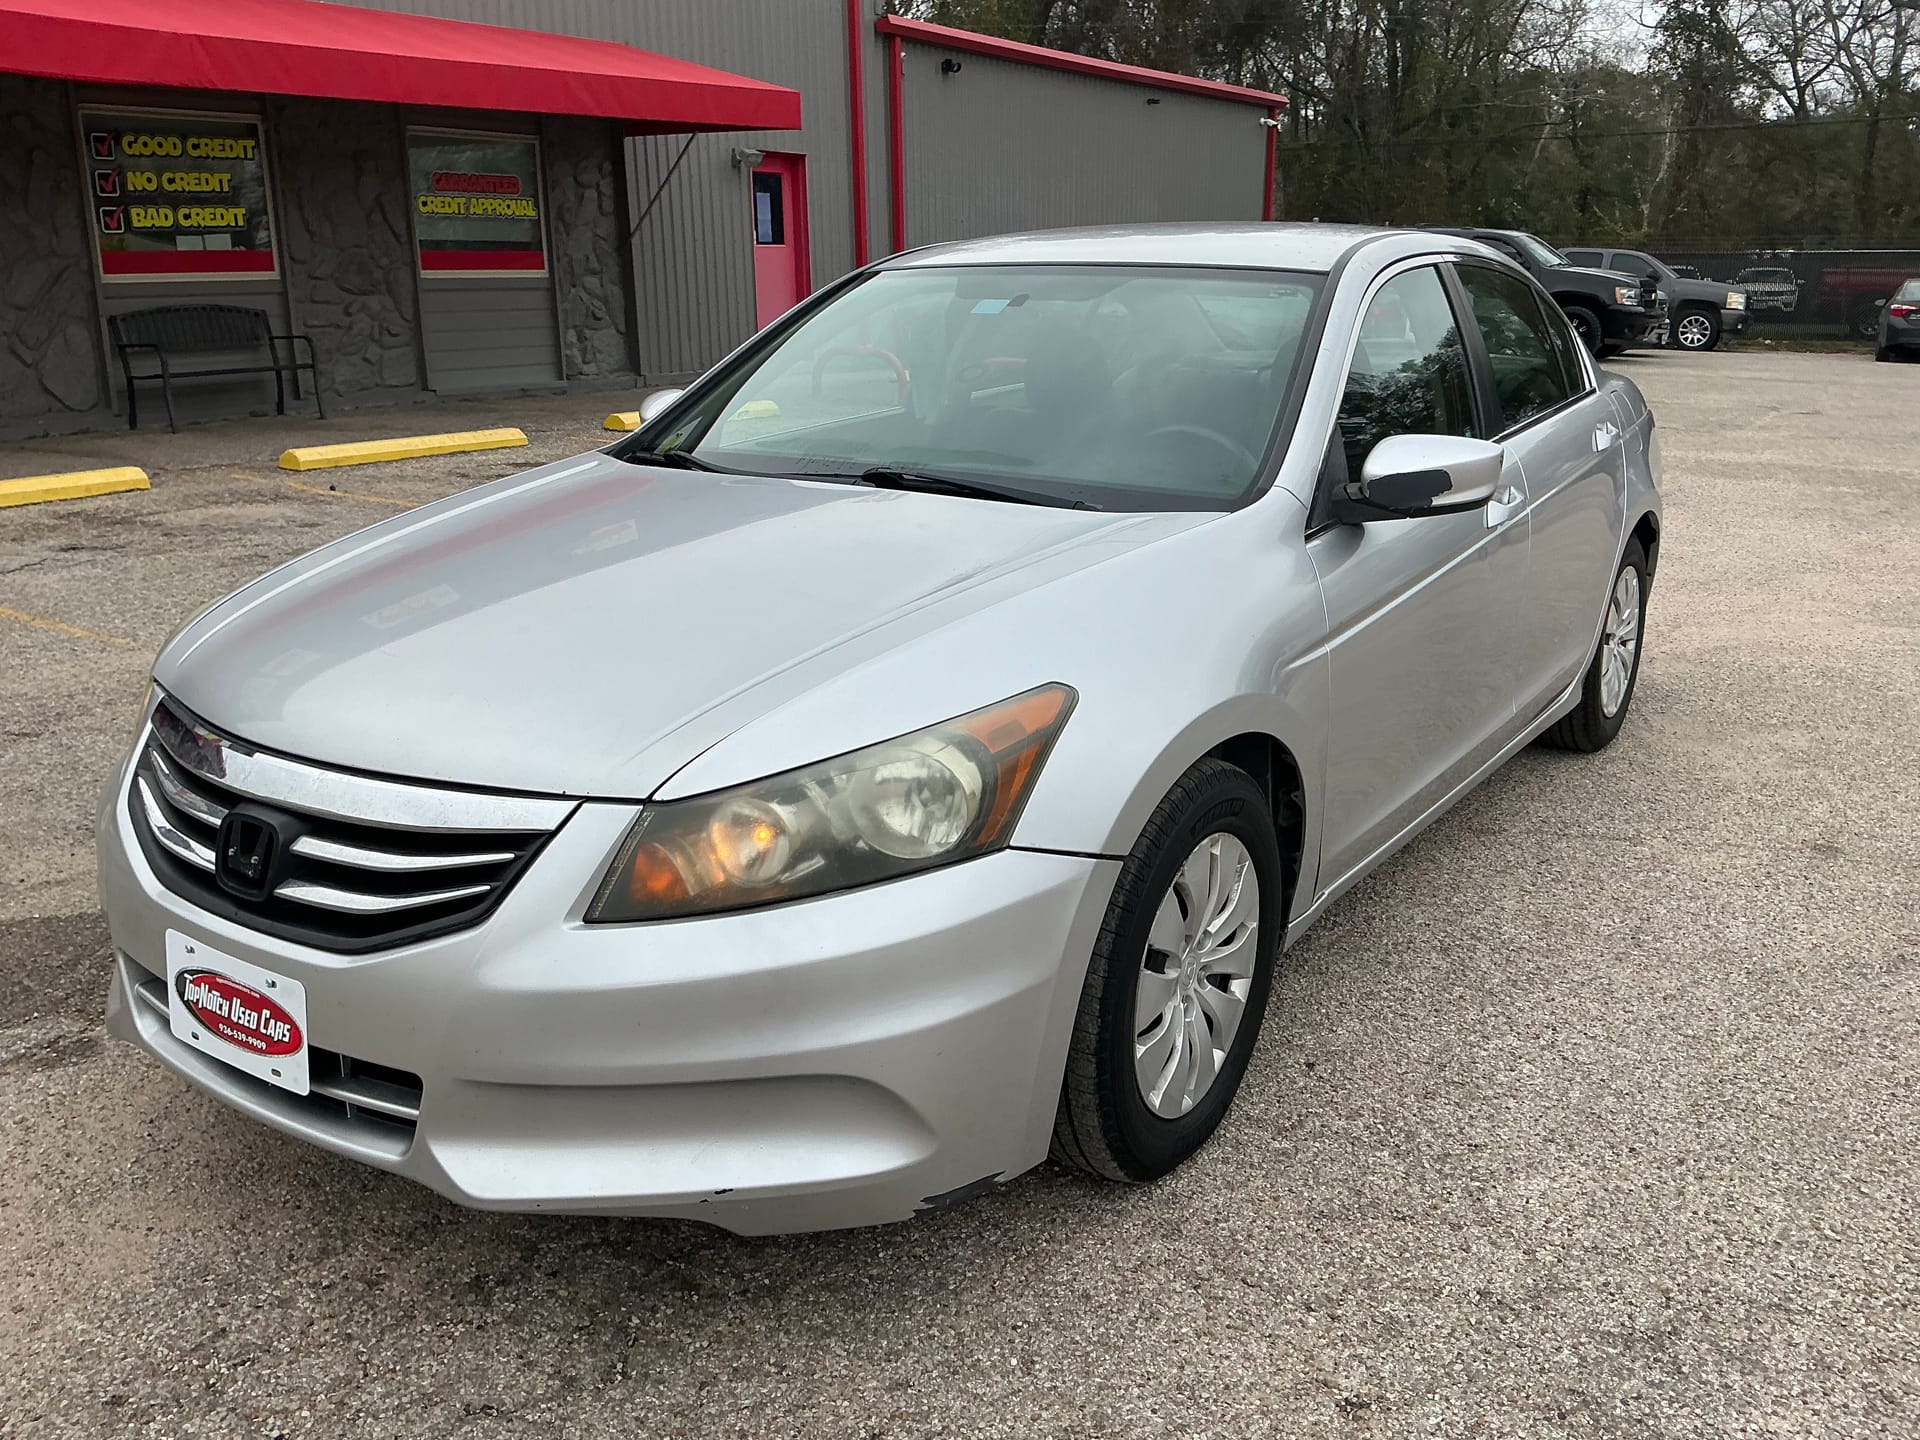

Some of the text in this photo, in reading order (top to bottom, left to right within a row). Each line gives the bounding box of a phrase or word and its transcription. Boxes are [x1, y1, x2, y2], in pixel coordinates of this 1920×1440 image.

[122, 135, 256, 160] GOOD CREDIT
[127, 171, 231, 193] NO CREDIT
[418, 195, 536, 217] CREDIT APPROVAL
[130, 207, 246, 228] BAD CREDIT
[231, 997, 258, 1030] USED
[259, 1009, 291, 1043] CARS
